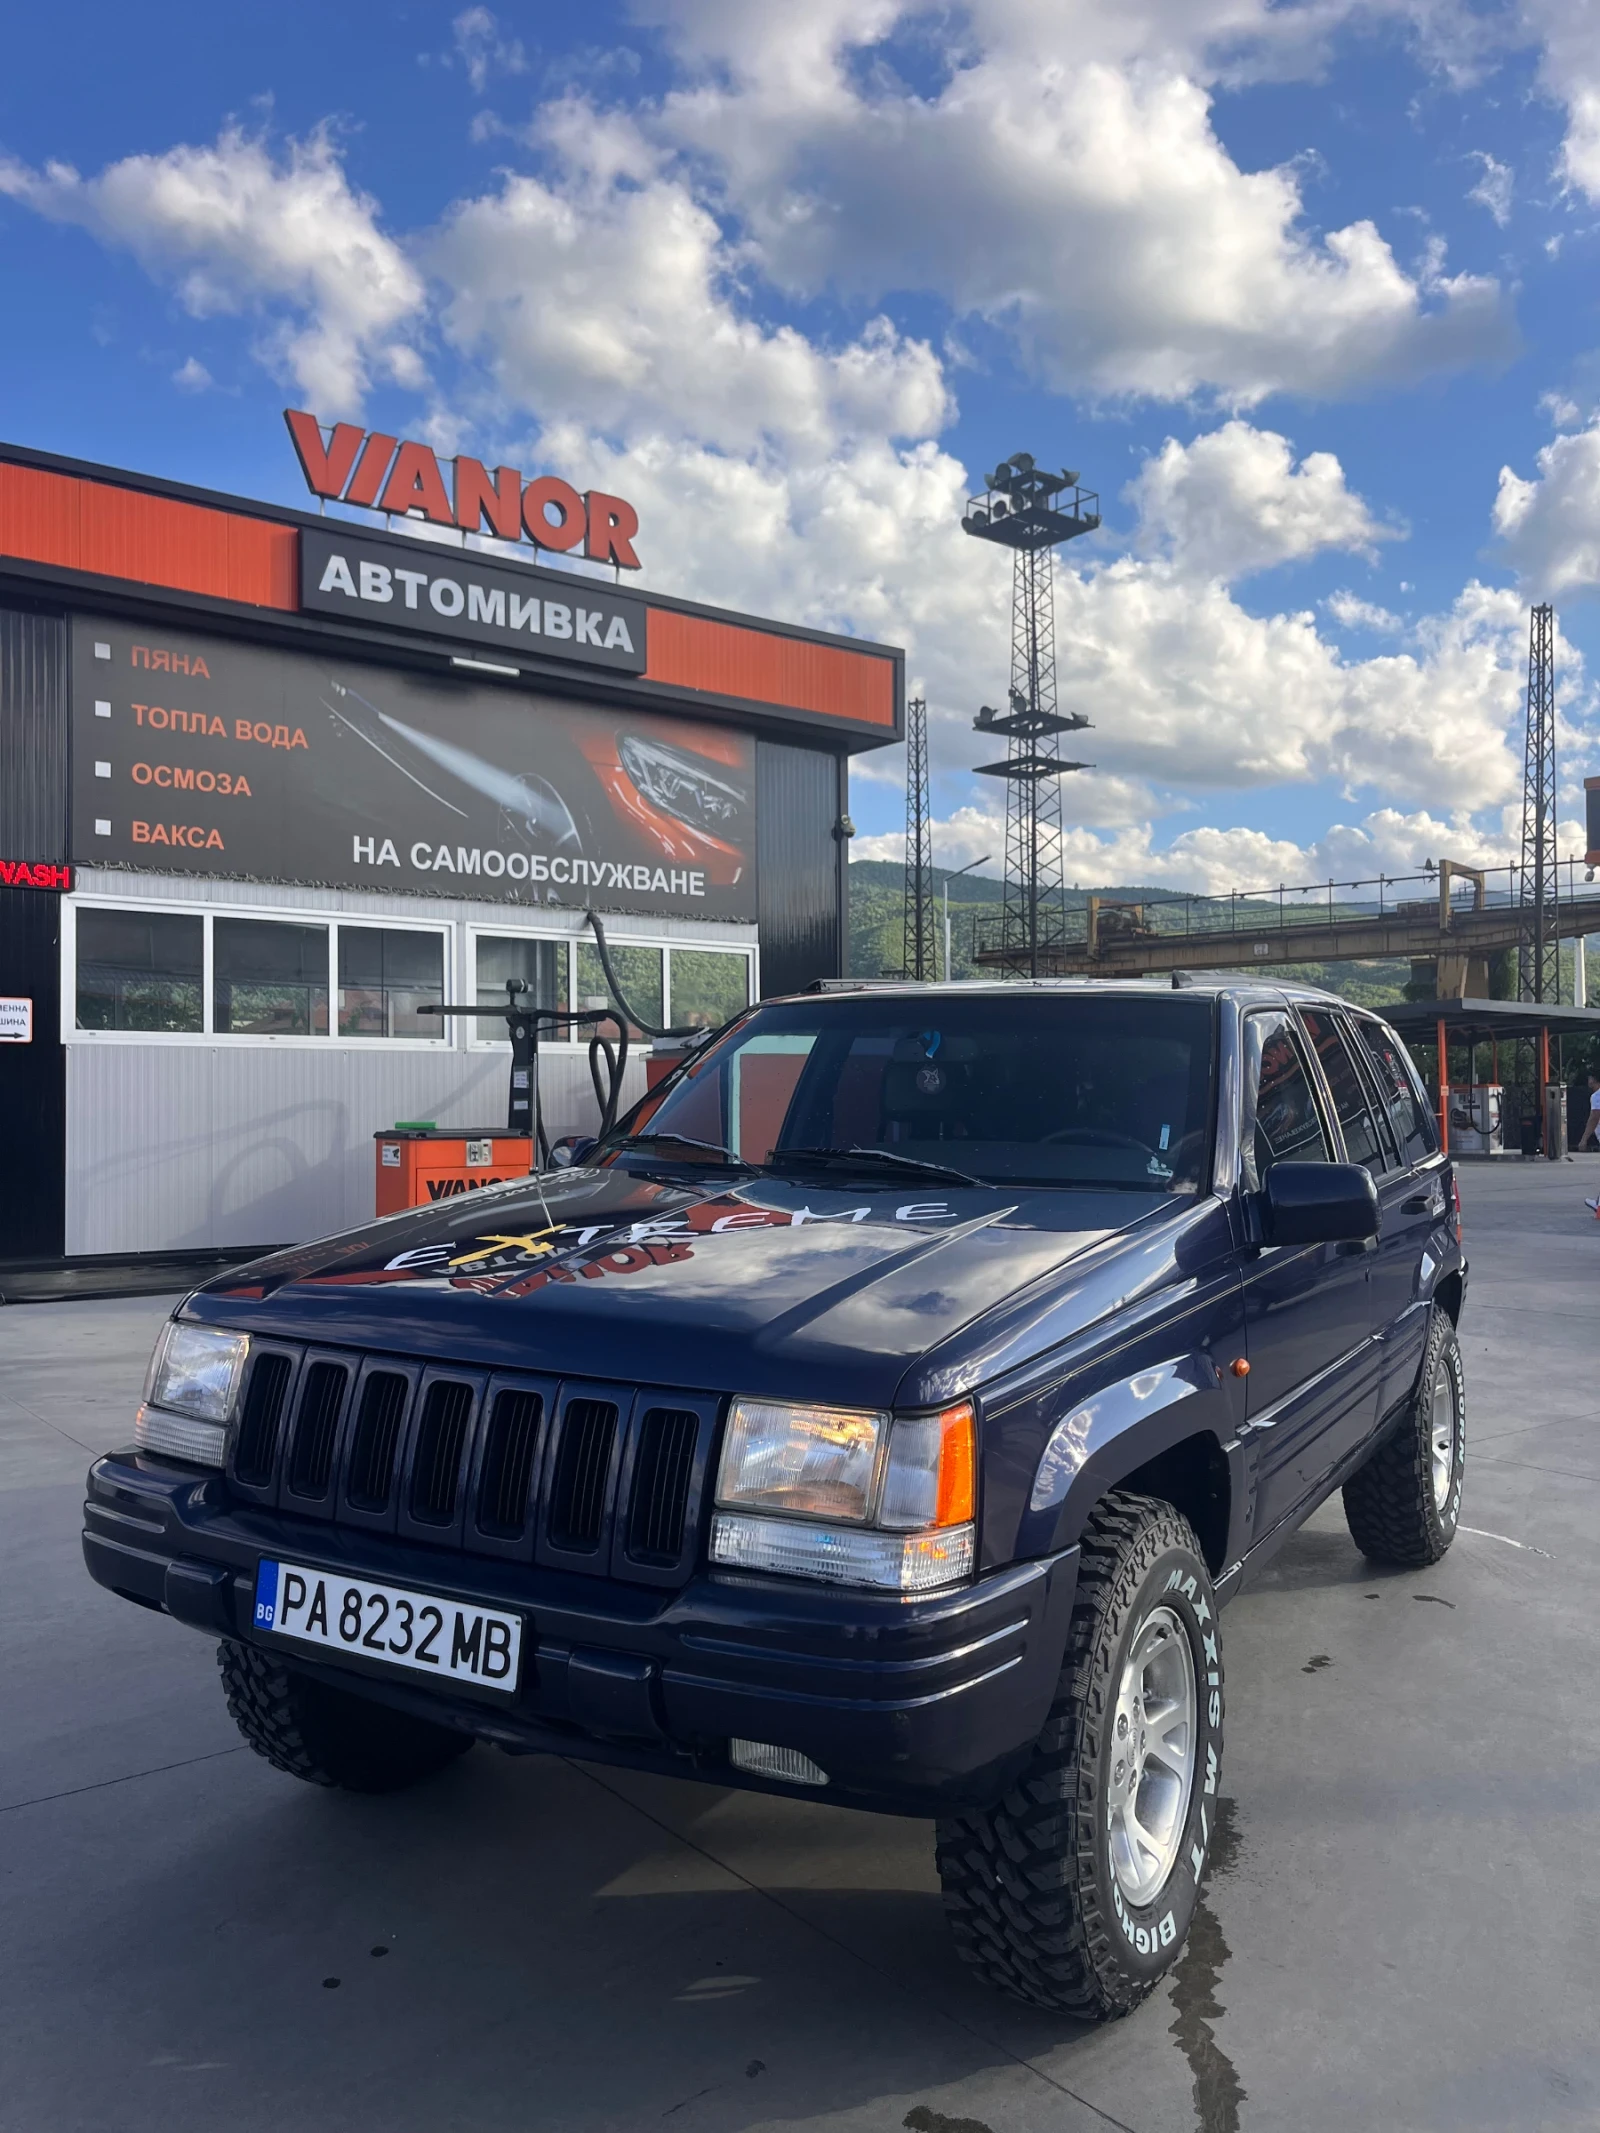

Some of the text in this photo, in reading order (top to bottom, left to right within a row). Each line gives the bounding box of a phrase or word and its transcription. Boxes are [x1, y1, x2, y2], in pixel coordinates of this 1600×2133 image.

[283, 408, 642, 570] VIANOR
[318, 554, 636, 653] АВТОМИВКА
[131, 645, 211, 679] ПЯНА
[131, 703, 309, 750] ТОПЛА ВОДА
[131, 762, 252, 797] ОСМОЗА
[132, 820, 225, 851] ВАКСА
[353, 835, 705, 897] НА САМООБСЛУЖВАНЕ
[256, 1603, 273, 1622] BG
[280, 1572, 512, 1679] PA 8232 MB
[1163, 1569, 1221, 1729] MAXXIS
